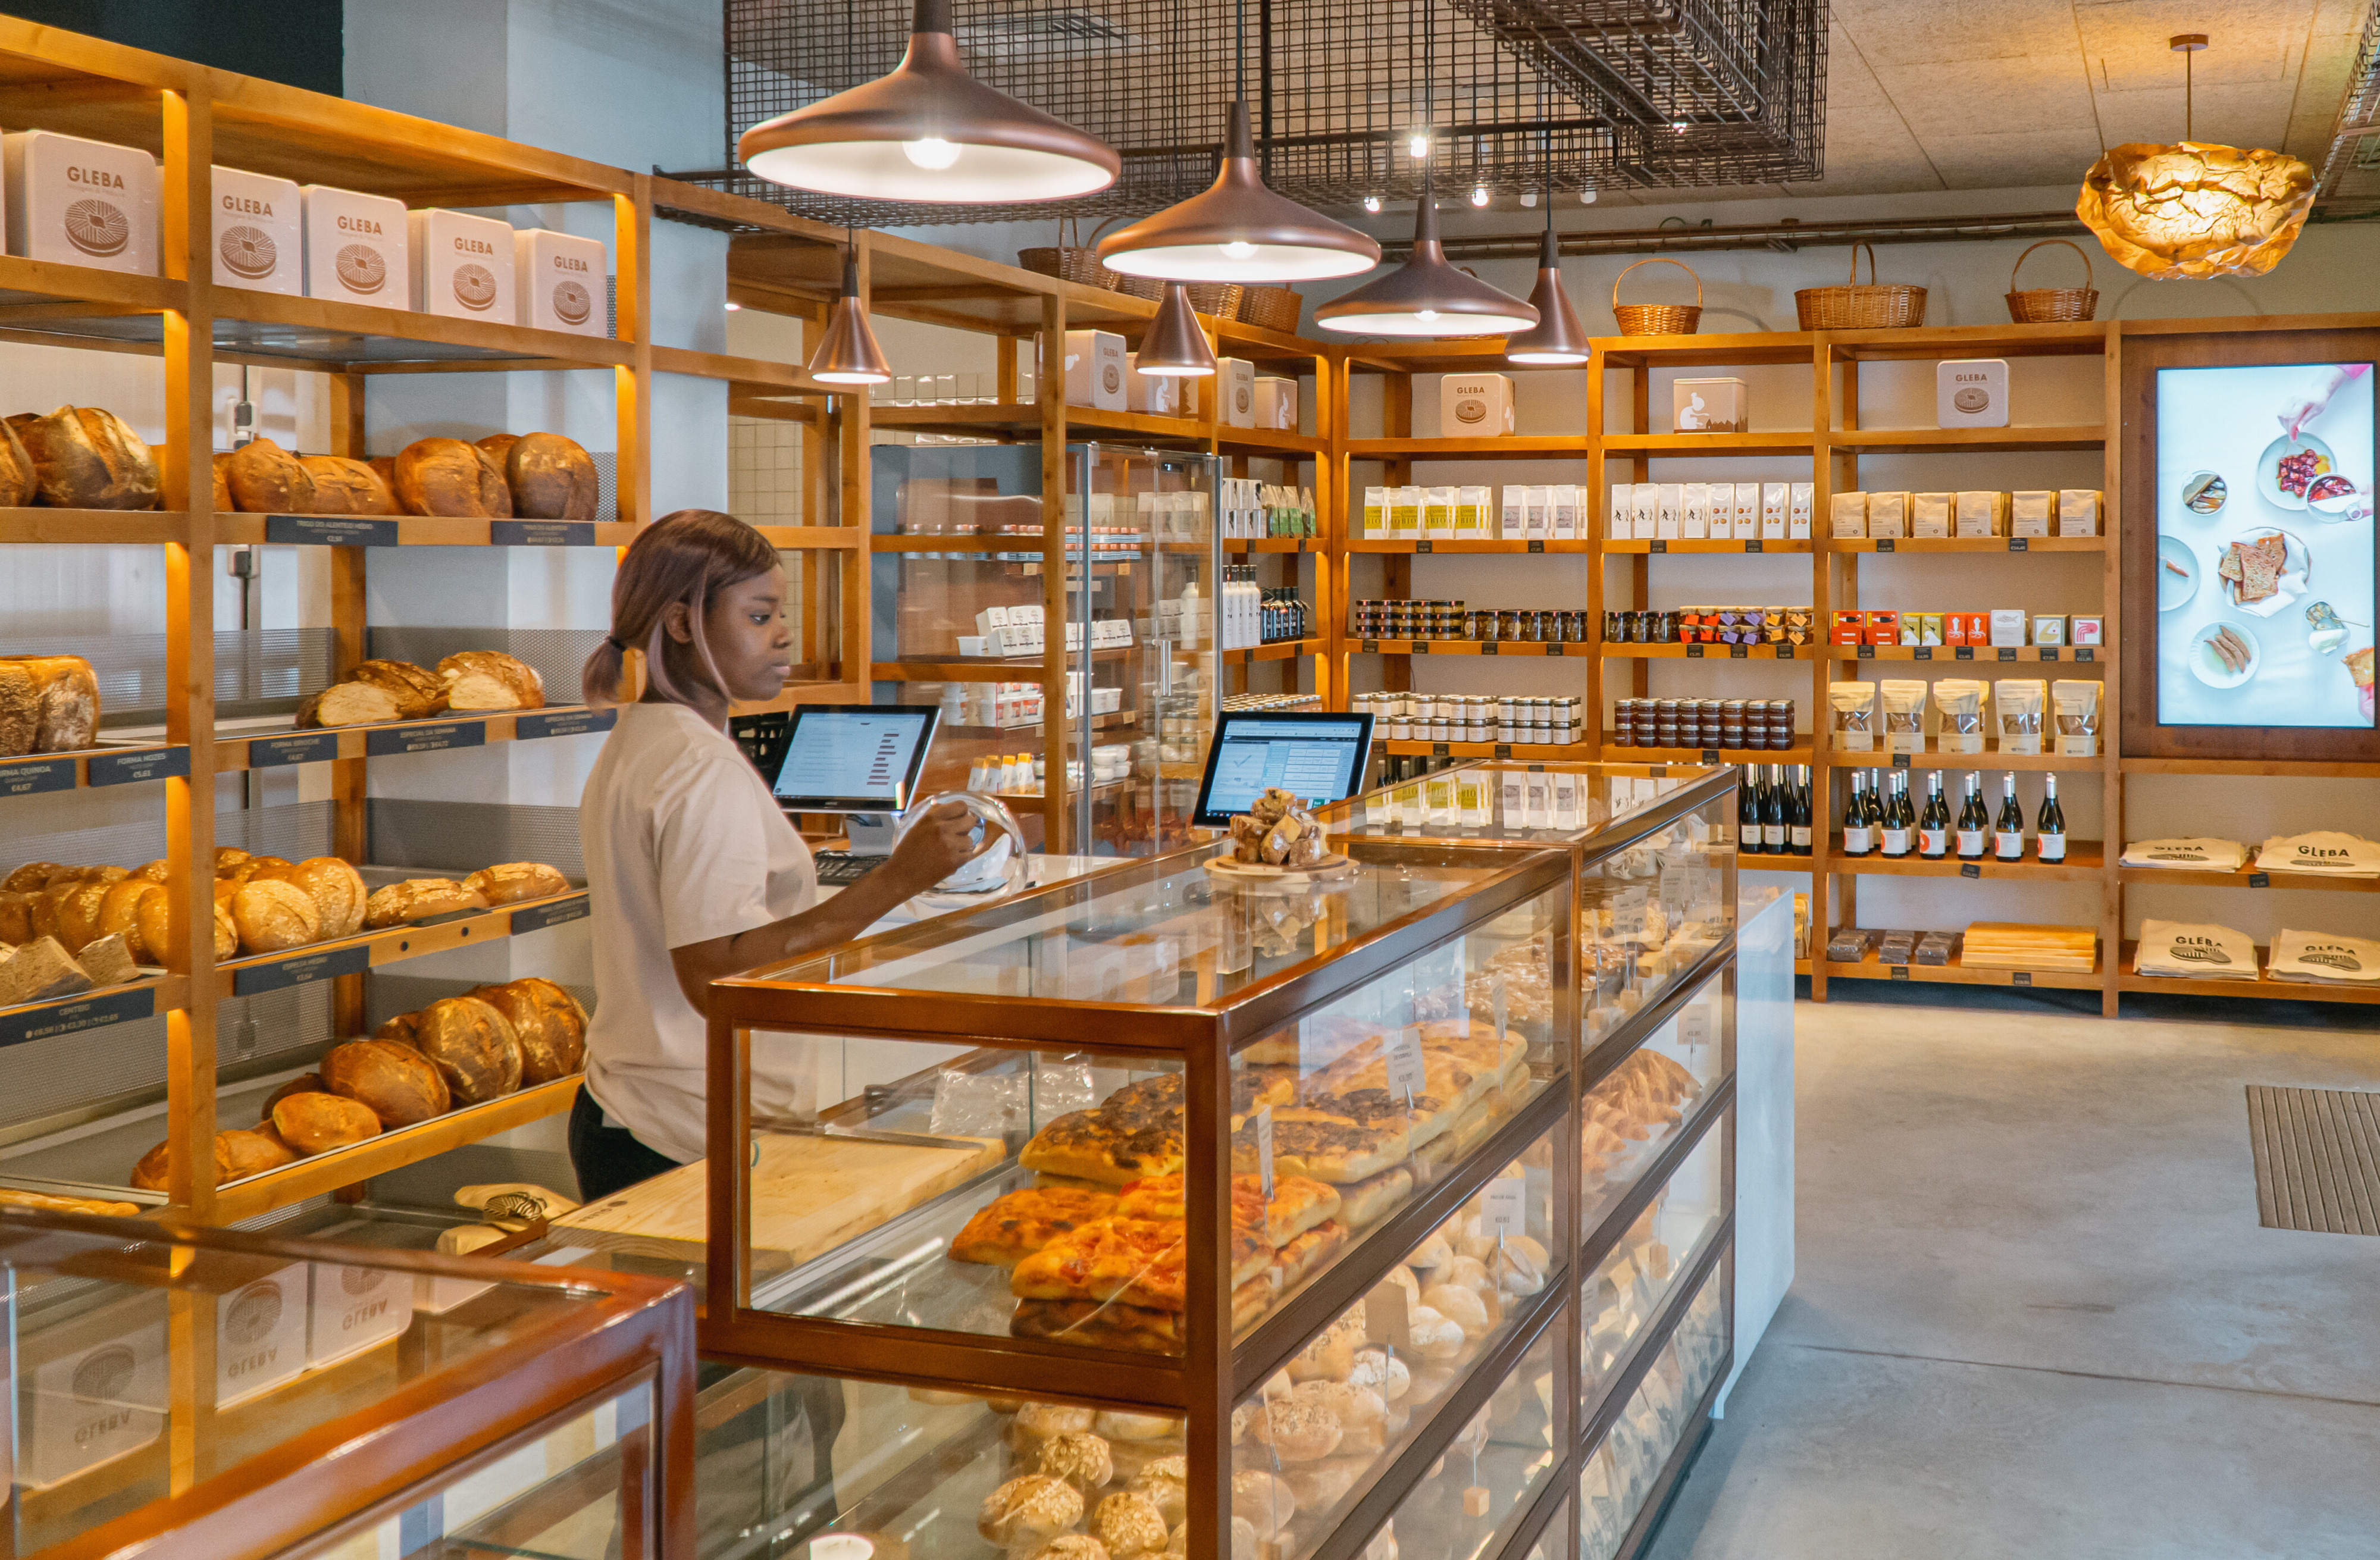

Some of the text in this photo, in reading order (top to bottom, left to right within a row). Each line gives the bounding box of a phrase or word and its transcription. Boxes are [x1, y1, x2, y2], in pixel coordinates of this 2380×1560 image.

[67, 166, 124, 190] GLEBA
[222, 195, 273, 217] GLEBA
[337, 215, 382, 236] GLEBA
[454, 237, 493, 255] GLEBA
[553, 255, 588, 272] GLEBA
[1103, 347, 1119, 358] GLEBA
[1956, 374, 1987, 382] GLEBA
[1457, 386, 1485, 394] GLEBA
[117, 756, 142, 765] FORMA
[20, 765, 52, 776] QUINOA
[2298, 845, 2350, 858] GLEBA
[2175, 936, 2223, 948] GLEBA
[2304, 945, 2357, 956] GLEBA
[60, 1003, 90, 1016] CENTEIO
